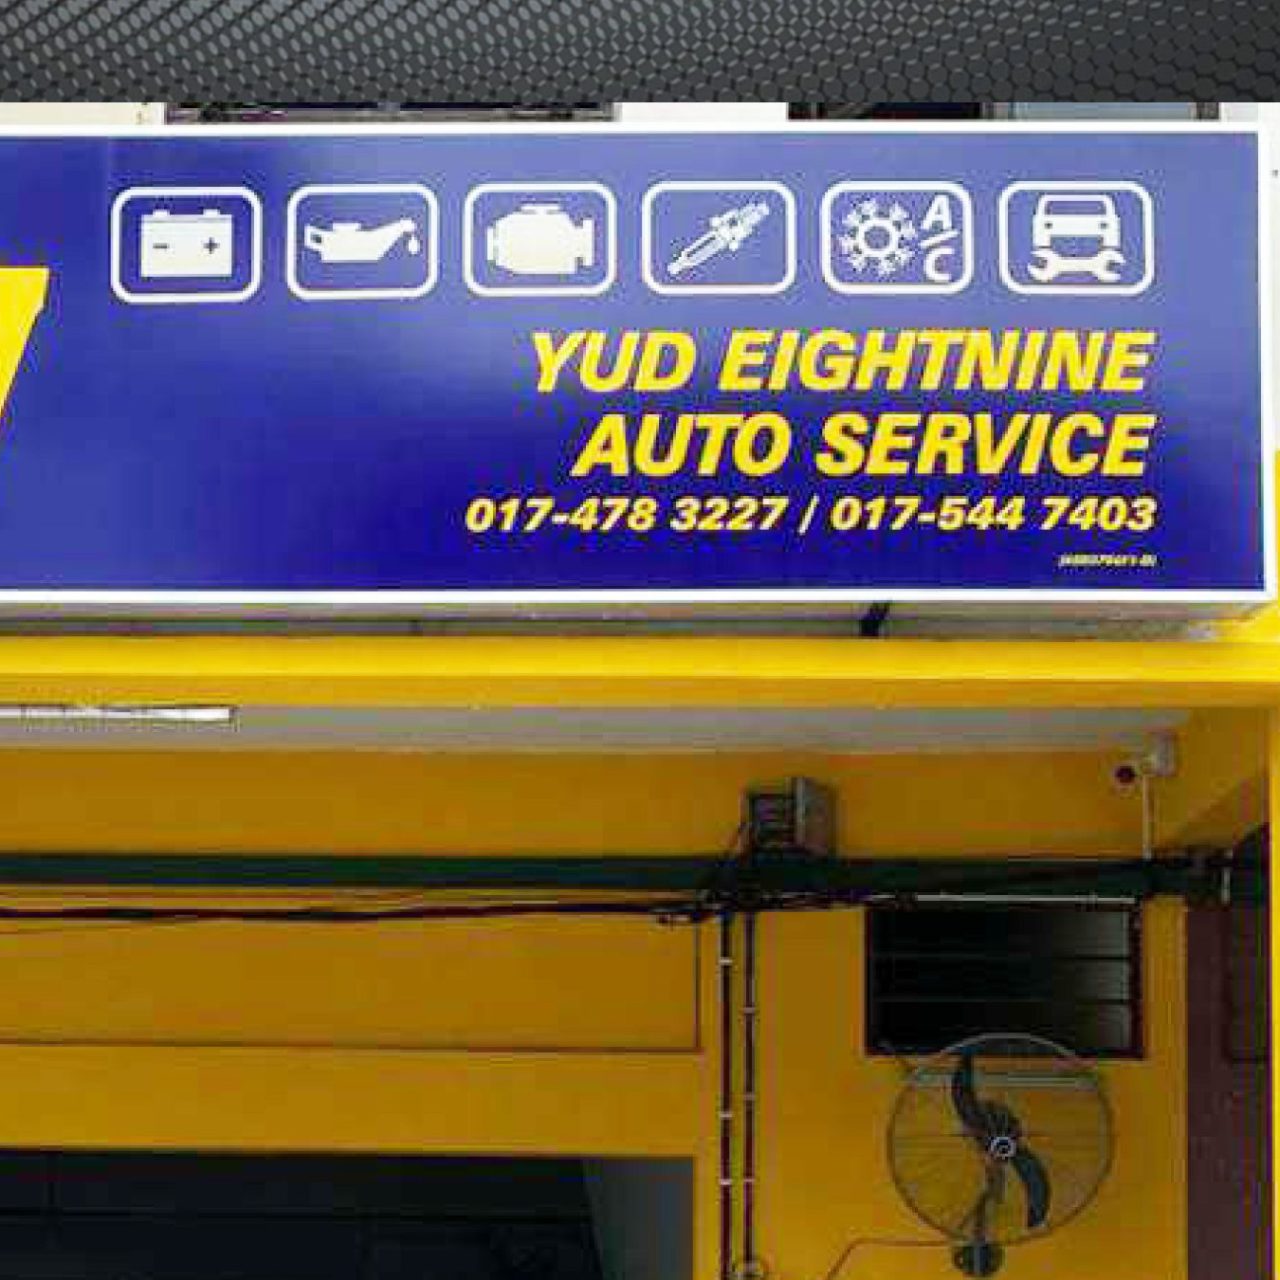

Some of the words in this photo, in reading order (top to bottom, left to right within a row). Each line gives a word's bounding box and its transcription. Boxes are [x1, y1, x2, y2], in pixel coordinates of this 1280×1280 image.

[532, 330, 697, 393] YUD
[718, 328, 1157, 391] EIGHTNINE
[570, 411, 792, 478] AUTO
[815, 412, 1157, 476] SERVICE
[466, 496, 658, 532] 017-478
[671, 496, 790, 531] 3227
[831, 495, 1026, 531] 017-544
[1041, 496, 1158, 531] 7403
